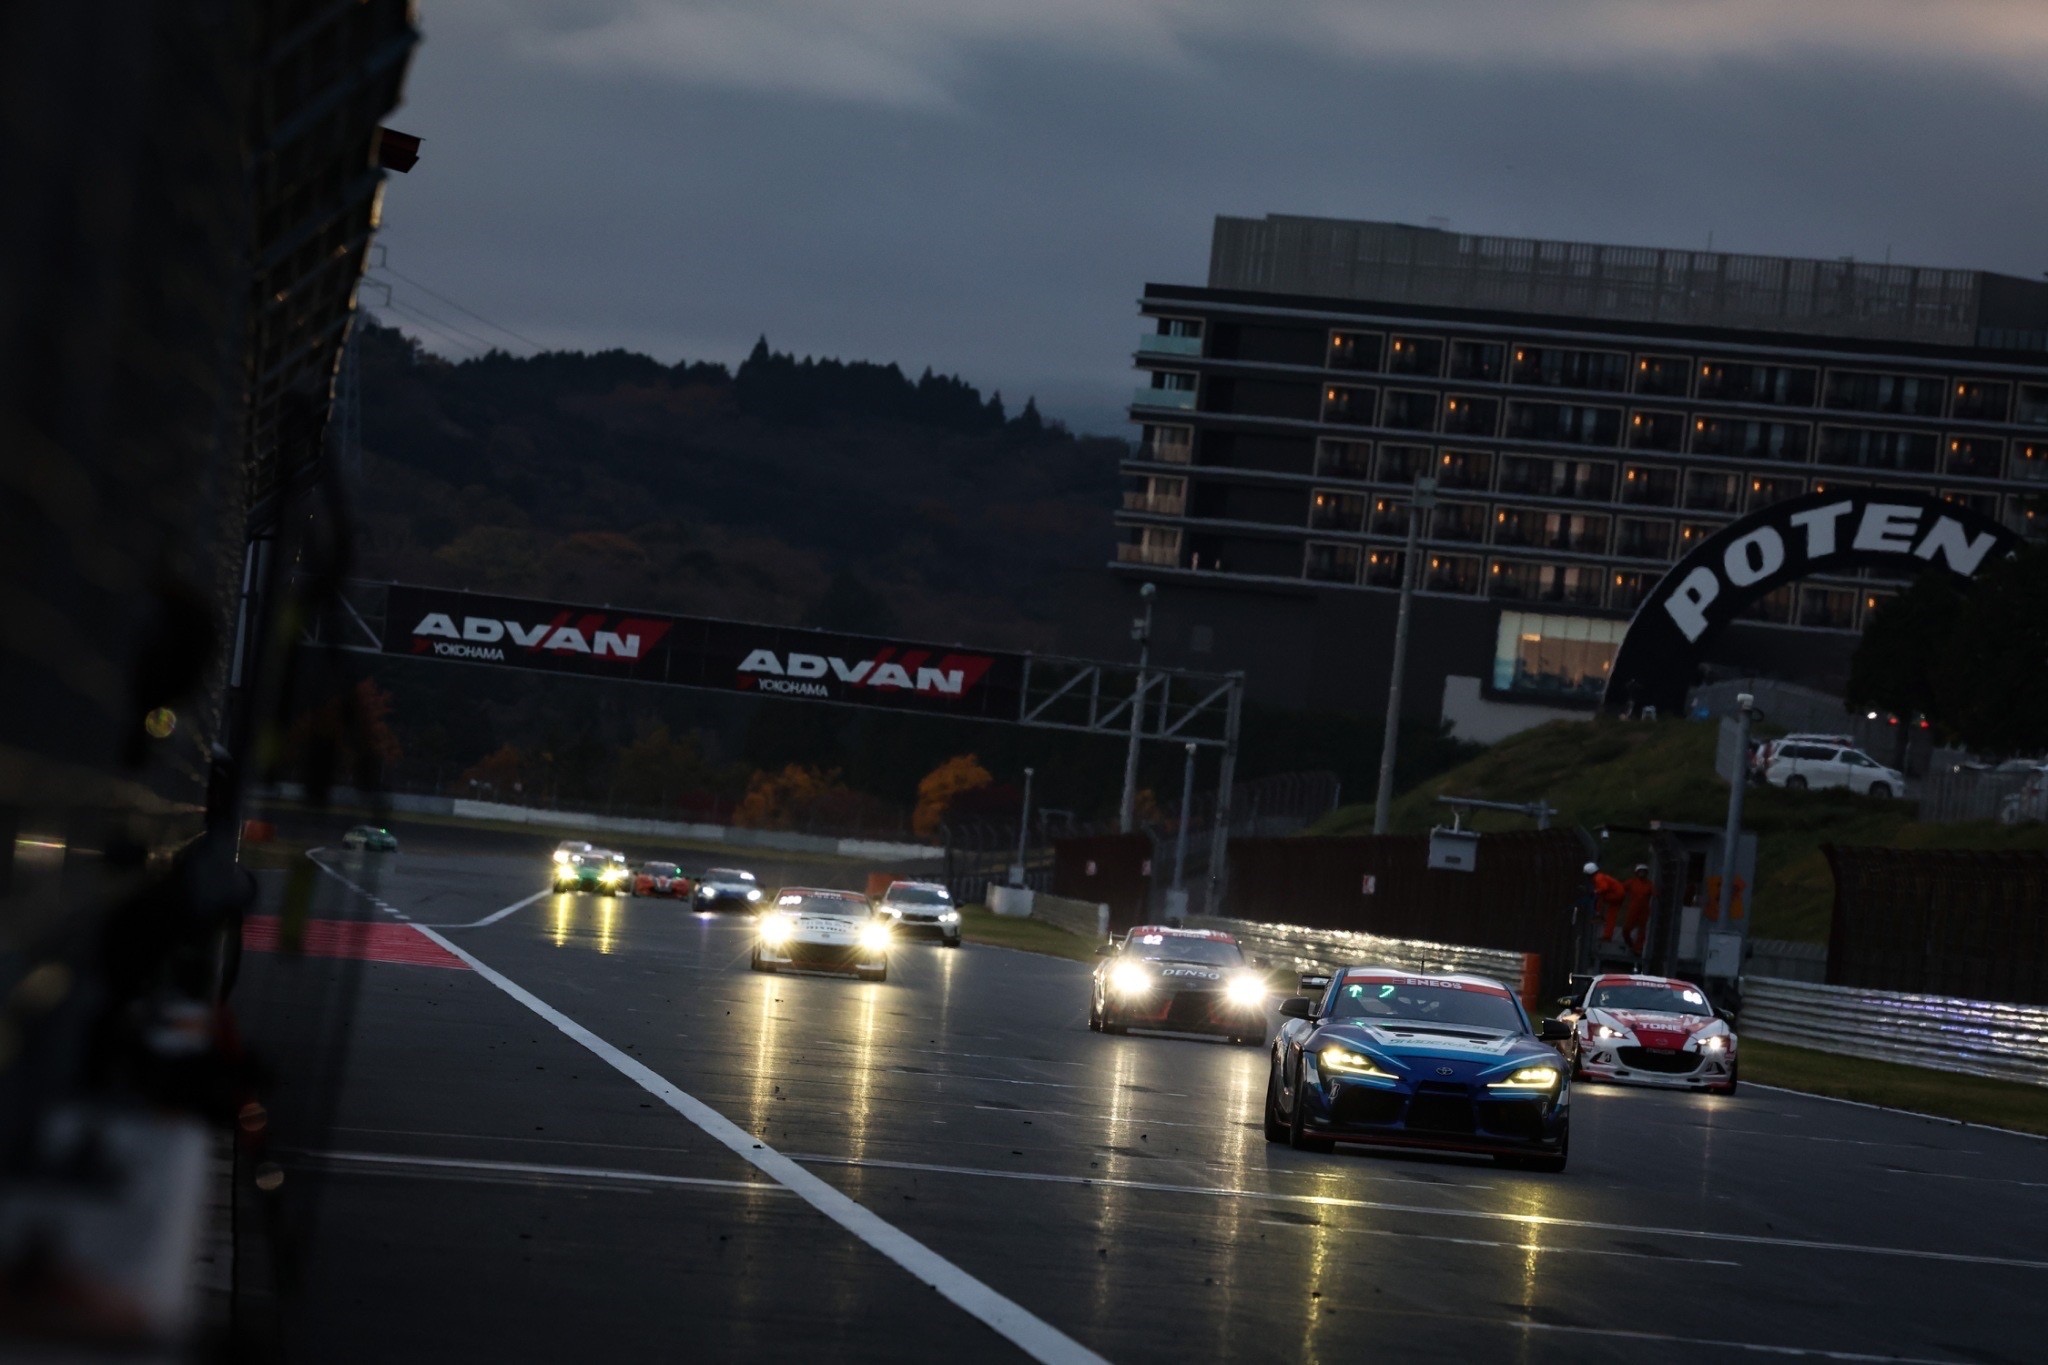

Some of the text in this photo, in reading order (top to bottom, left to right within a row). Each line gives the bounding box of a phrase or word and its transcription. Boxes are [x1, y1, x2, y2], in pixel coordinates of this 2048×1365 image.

[1663, 500, 1998, 644] POTEN
[411, 612, 640, 658] ADVAN
[433, 641, 505, 661] YOKOHAMA
[736, 648, 964, 694] ADVAN
[757, 677, 829, 697] YOKOHAMA
[1162, 969, 1221, 980] DENSO
[1406, 978, 1463, 990] ENEOS
[1639, 1022, 1682, 1032] TONE
